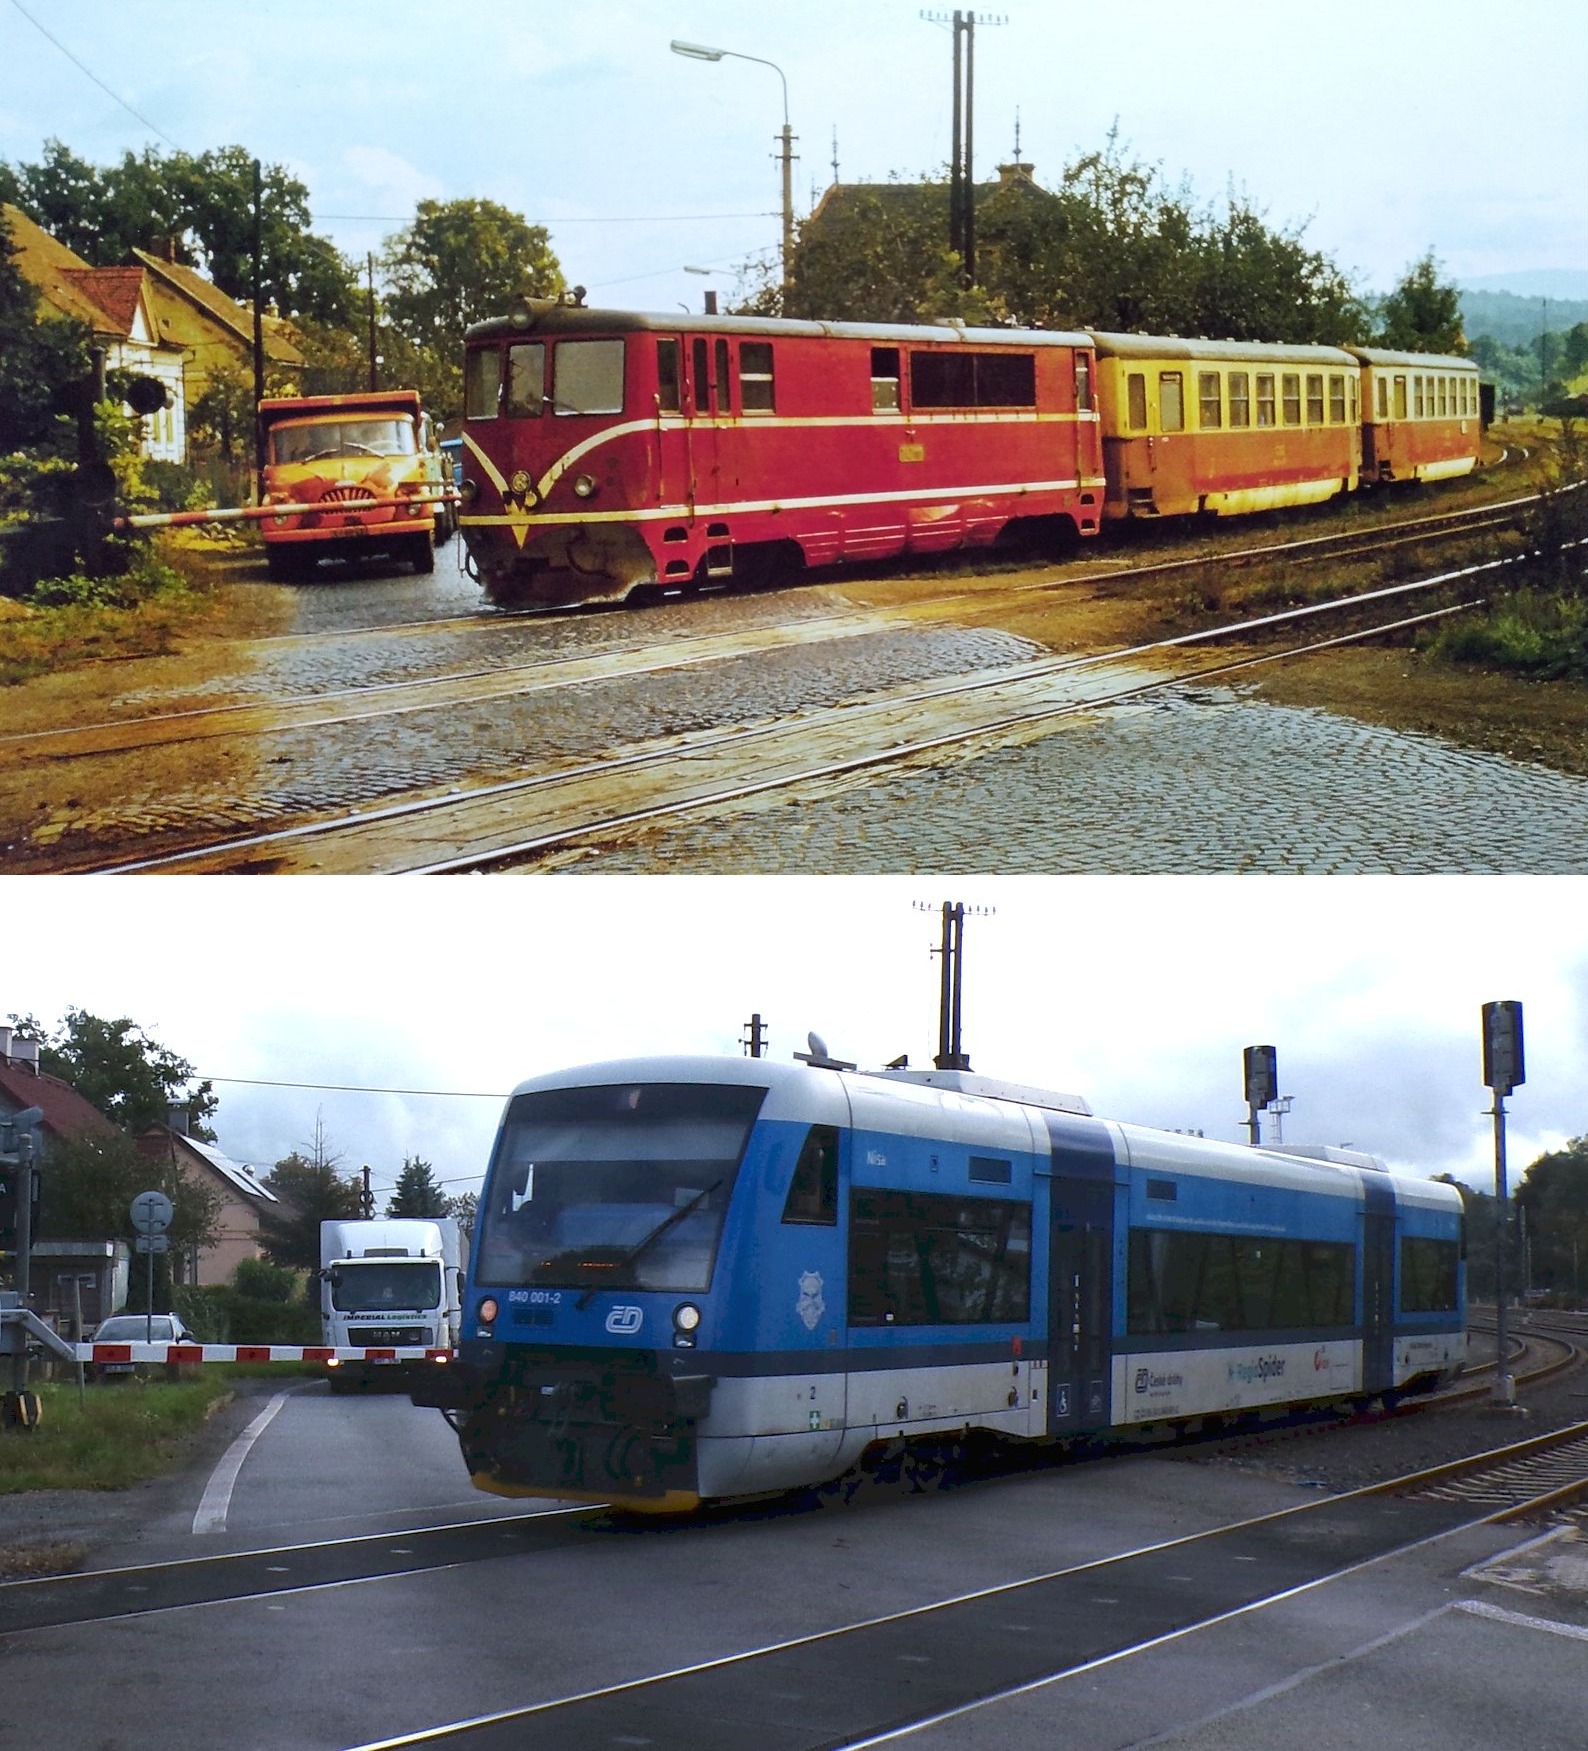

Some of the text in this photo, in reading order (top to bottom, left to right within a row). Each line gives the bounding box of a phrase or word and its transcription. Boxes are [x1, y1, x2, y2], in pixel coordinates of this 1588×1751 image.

[508, 1290, 561, 1304] 840 001-2
[809, 1386, 817, 1400] 2
